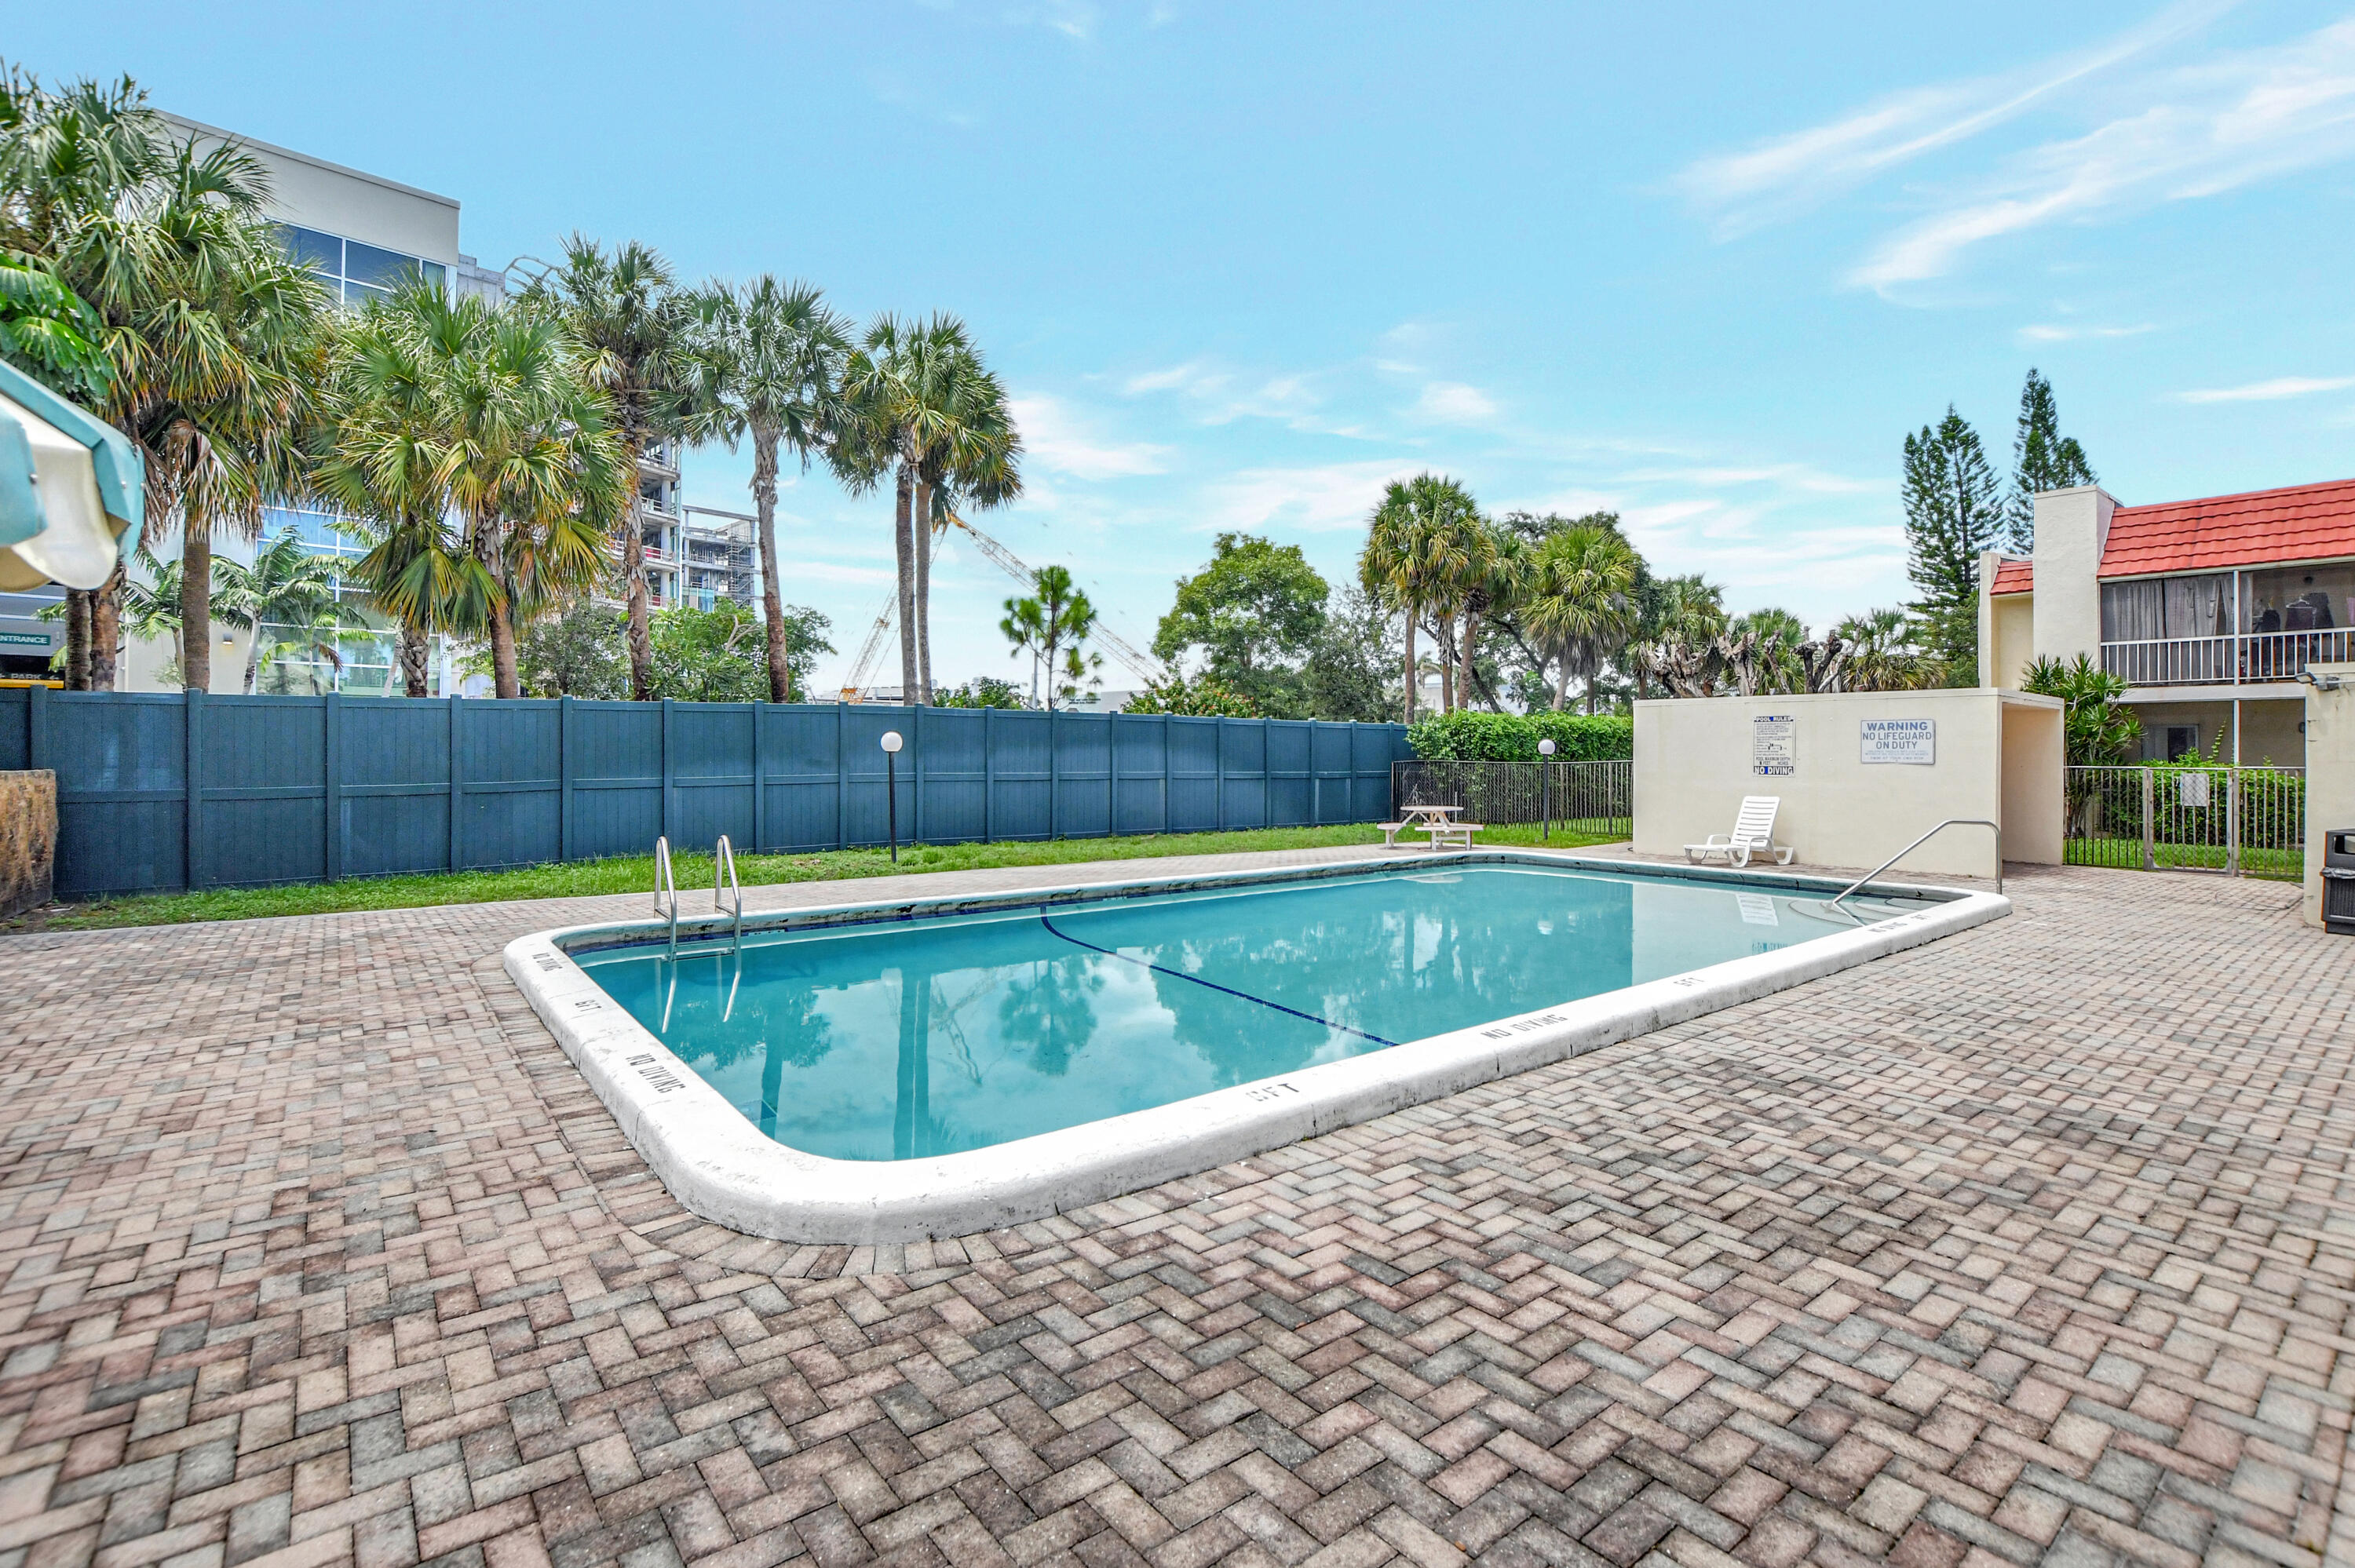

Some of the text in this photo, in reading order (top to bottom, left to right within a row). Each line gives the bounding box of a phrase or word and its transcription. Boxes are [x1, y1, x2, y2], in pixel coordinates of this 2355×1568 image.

[0, 635, 47, 644] NTRANCE
[1867, 721, 1928, 731] WARNING
[1862, 731, 1932, 741] NO LIFEGUARD
[1875, 741, 1918, 749] ON DUTY
[1754, 766, 1793, 775] NO DIVING
[1481, 1014, 1568, 1040] NO DIVING
[625, 1052, 686, 1093] NO DIVING
